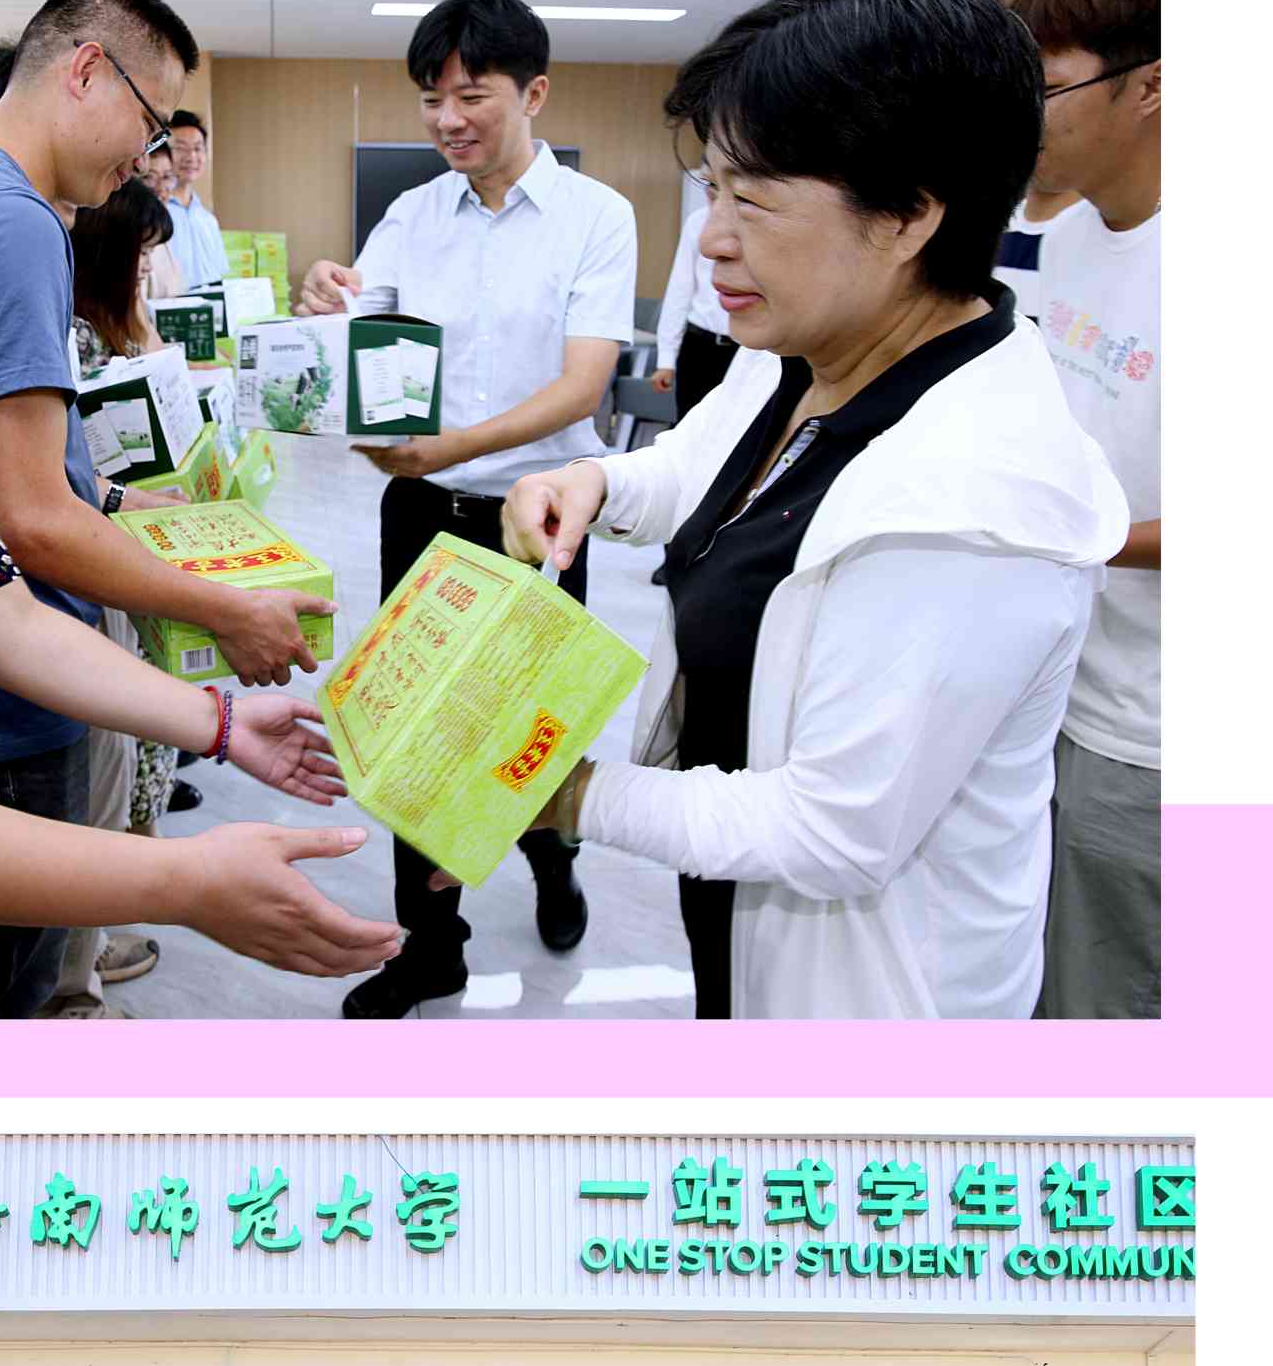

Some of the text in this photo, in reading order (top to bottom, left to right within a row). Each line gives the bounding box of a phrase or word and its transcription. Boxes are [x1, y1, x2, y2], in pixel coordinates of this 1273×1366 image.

[580, 1156, 1196, 1232] 一站式学生社区
[580, 1236, 670, 1274] ONE
[678, 1238, 791, 1276] STOP
[796, 1240, 990, 1278] STUDENT
